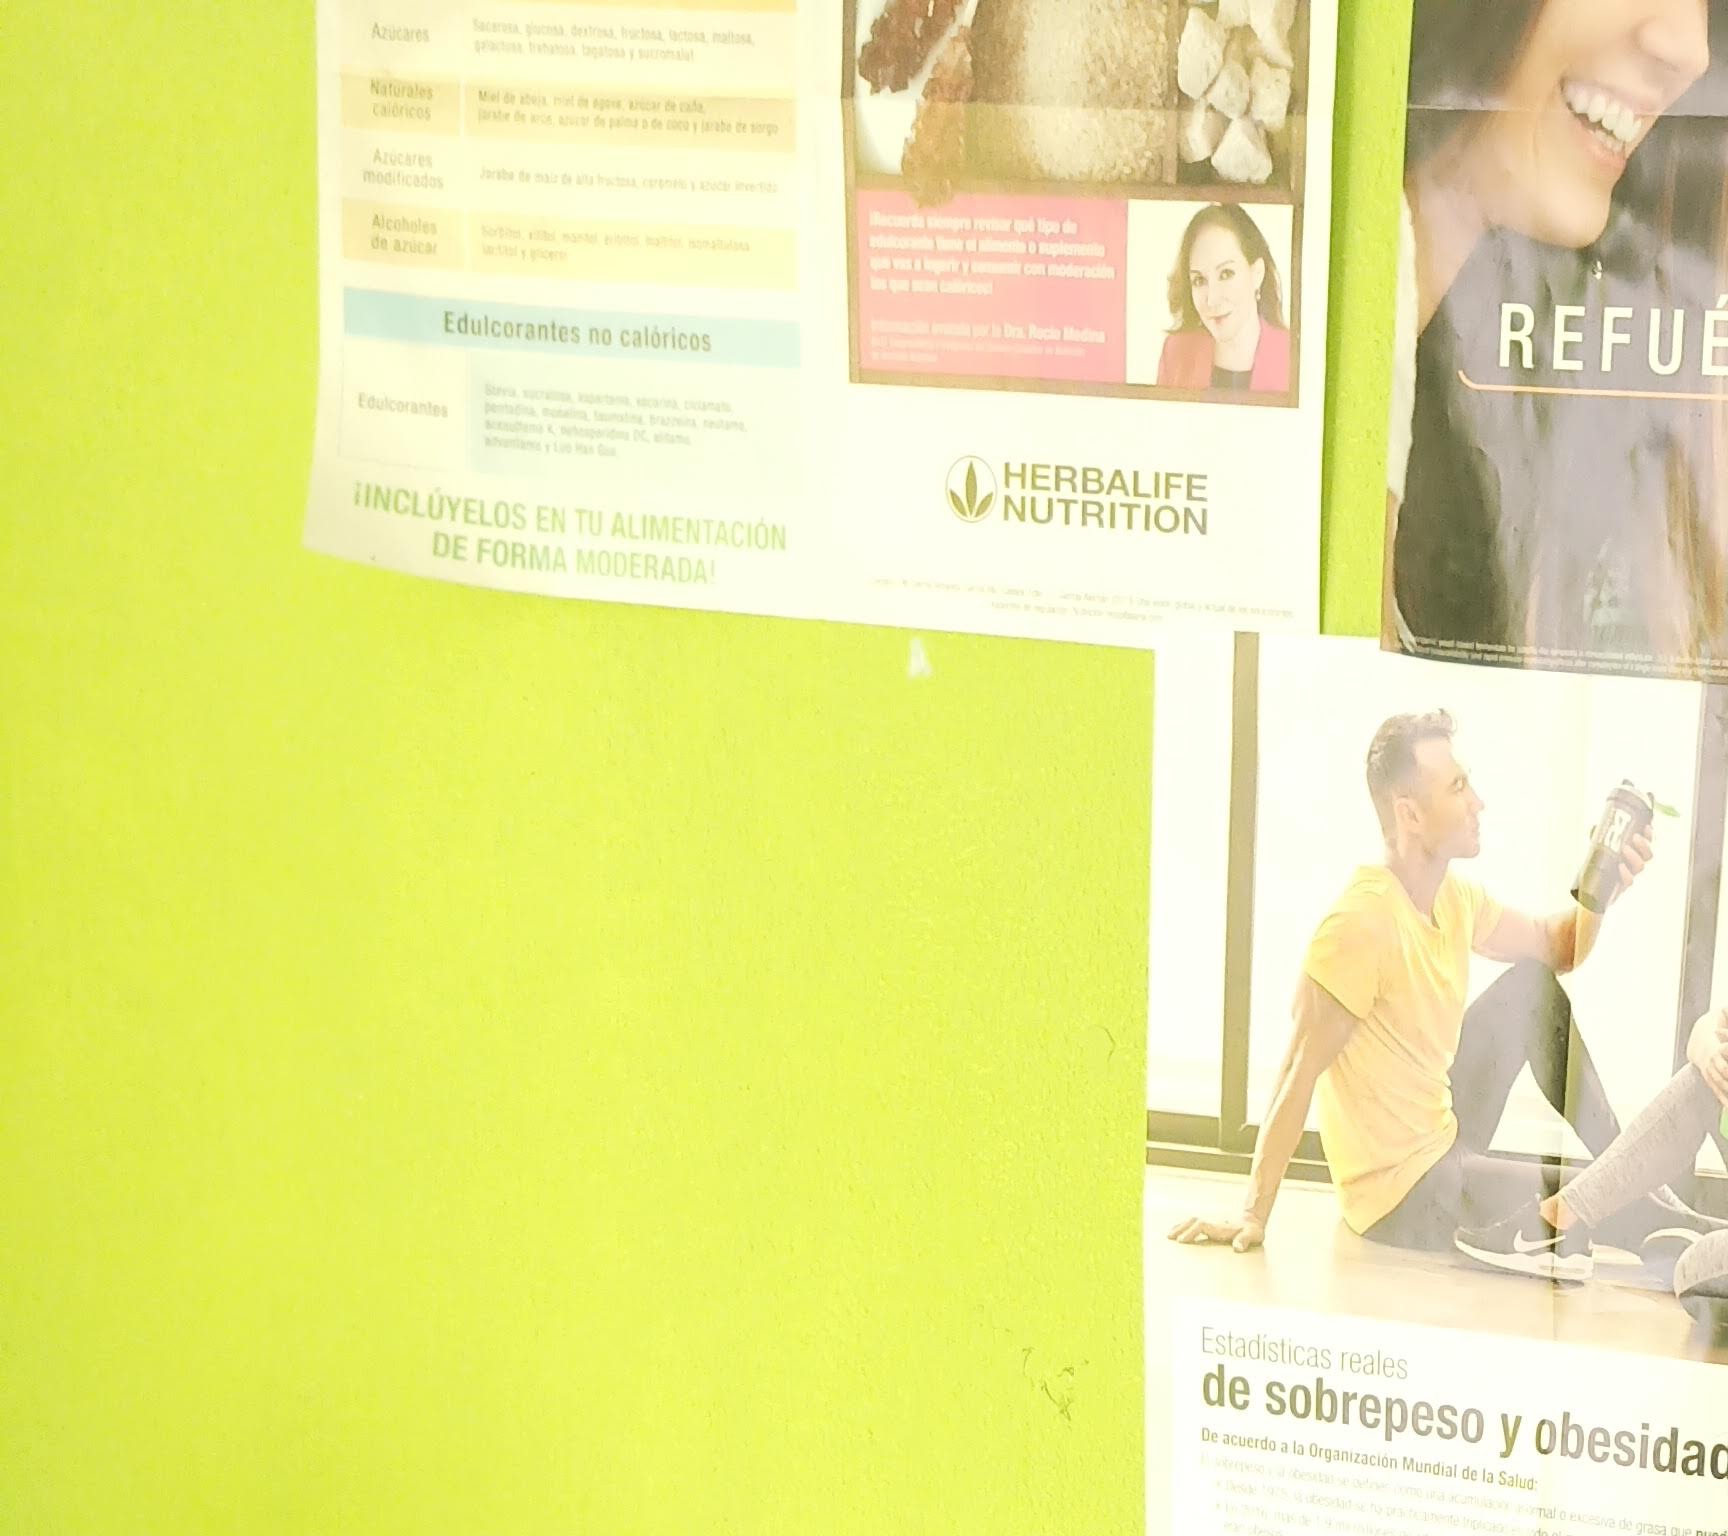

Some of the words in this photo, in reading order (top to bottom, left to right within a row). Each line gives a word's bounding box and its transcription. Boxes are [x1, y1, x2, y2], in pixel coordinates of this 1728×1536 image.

[444, 311, 579, 343] Edulcorantes
[588, 327, 611, 345] no
[619, 326, 710, 351] calóricos
[1003, 461, 1208, 503] HERBALIFE
[536, 505, 566, 535] EN
[575, 507, 603, 538] TU
[611, 511, 788, 551] ALIMENTACIÓN
[1003, 496, 1208, 535] NUTRITION
[432, 531, 466, 560] DE
[477, 538, 566, 571] FORMA
[576, 546, 714, 583] MODERADA!
[1201, 1326, 1331, 1368] Estadísticas
[1340, 1351, 1407, 1379] reales
[1202, 1364, 1249, 1409] de
[1266, 1377, 1484, 1444] sobrepeso
[1500, 1412, 1523, 1458] y
[1201, 1427, 1218, 1443] De
[1222, 1433, 1276, 1451] acuerdo
[1280, 1441, 1288, 1453] a
[1292, 1440, 1304, 1455] la
[1309, 1443, 1397, 1468] Organización
[1402, 1456, 1456, 1477] Mundial
[1461, 1465, 1477, 1481] de
[1482, 1467, 1493, 1483] la
[1498, 1470, 1537, 1490] Salud:
